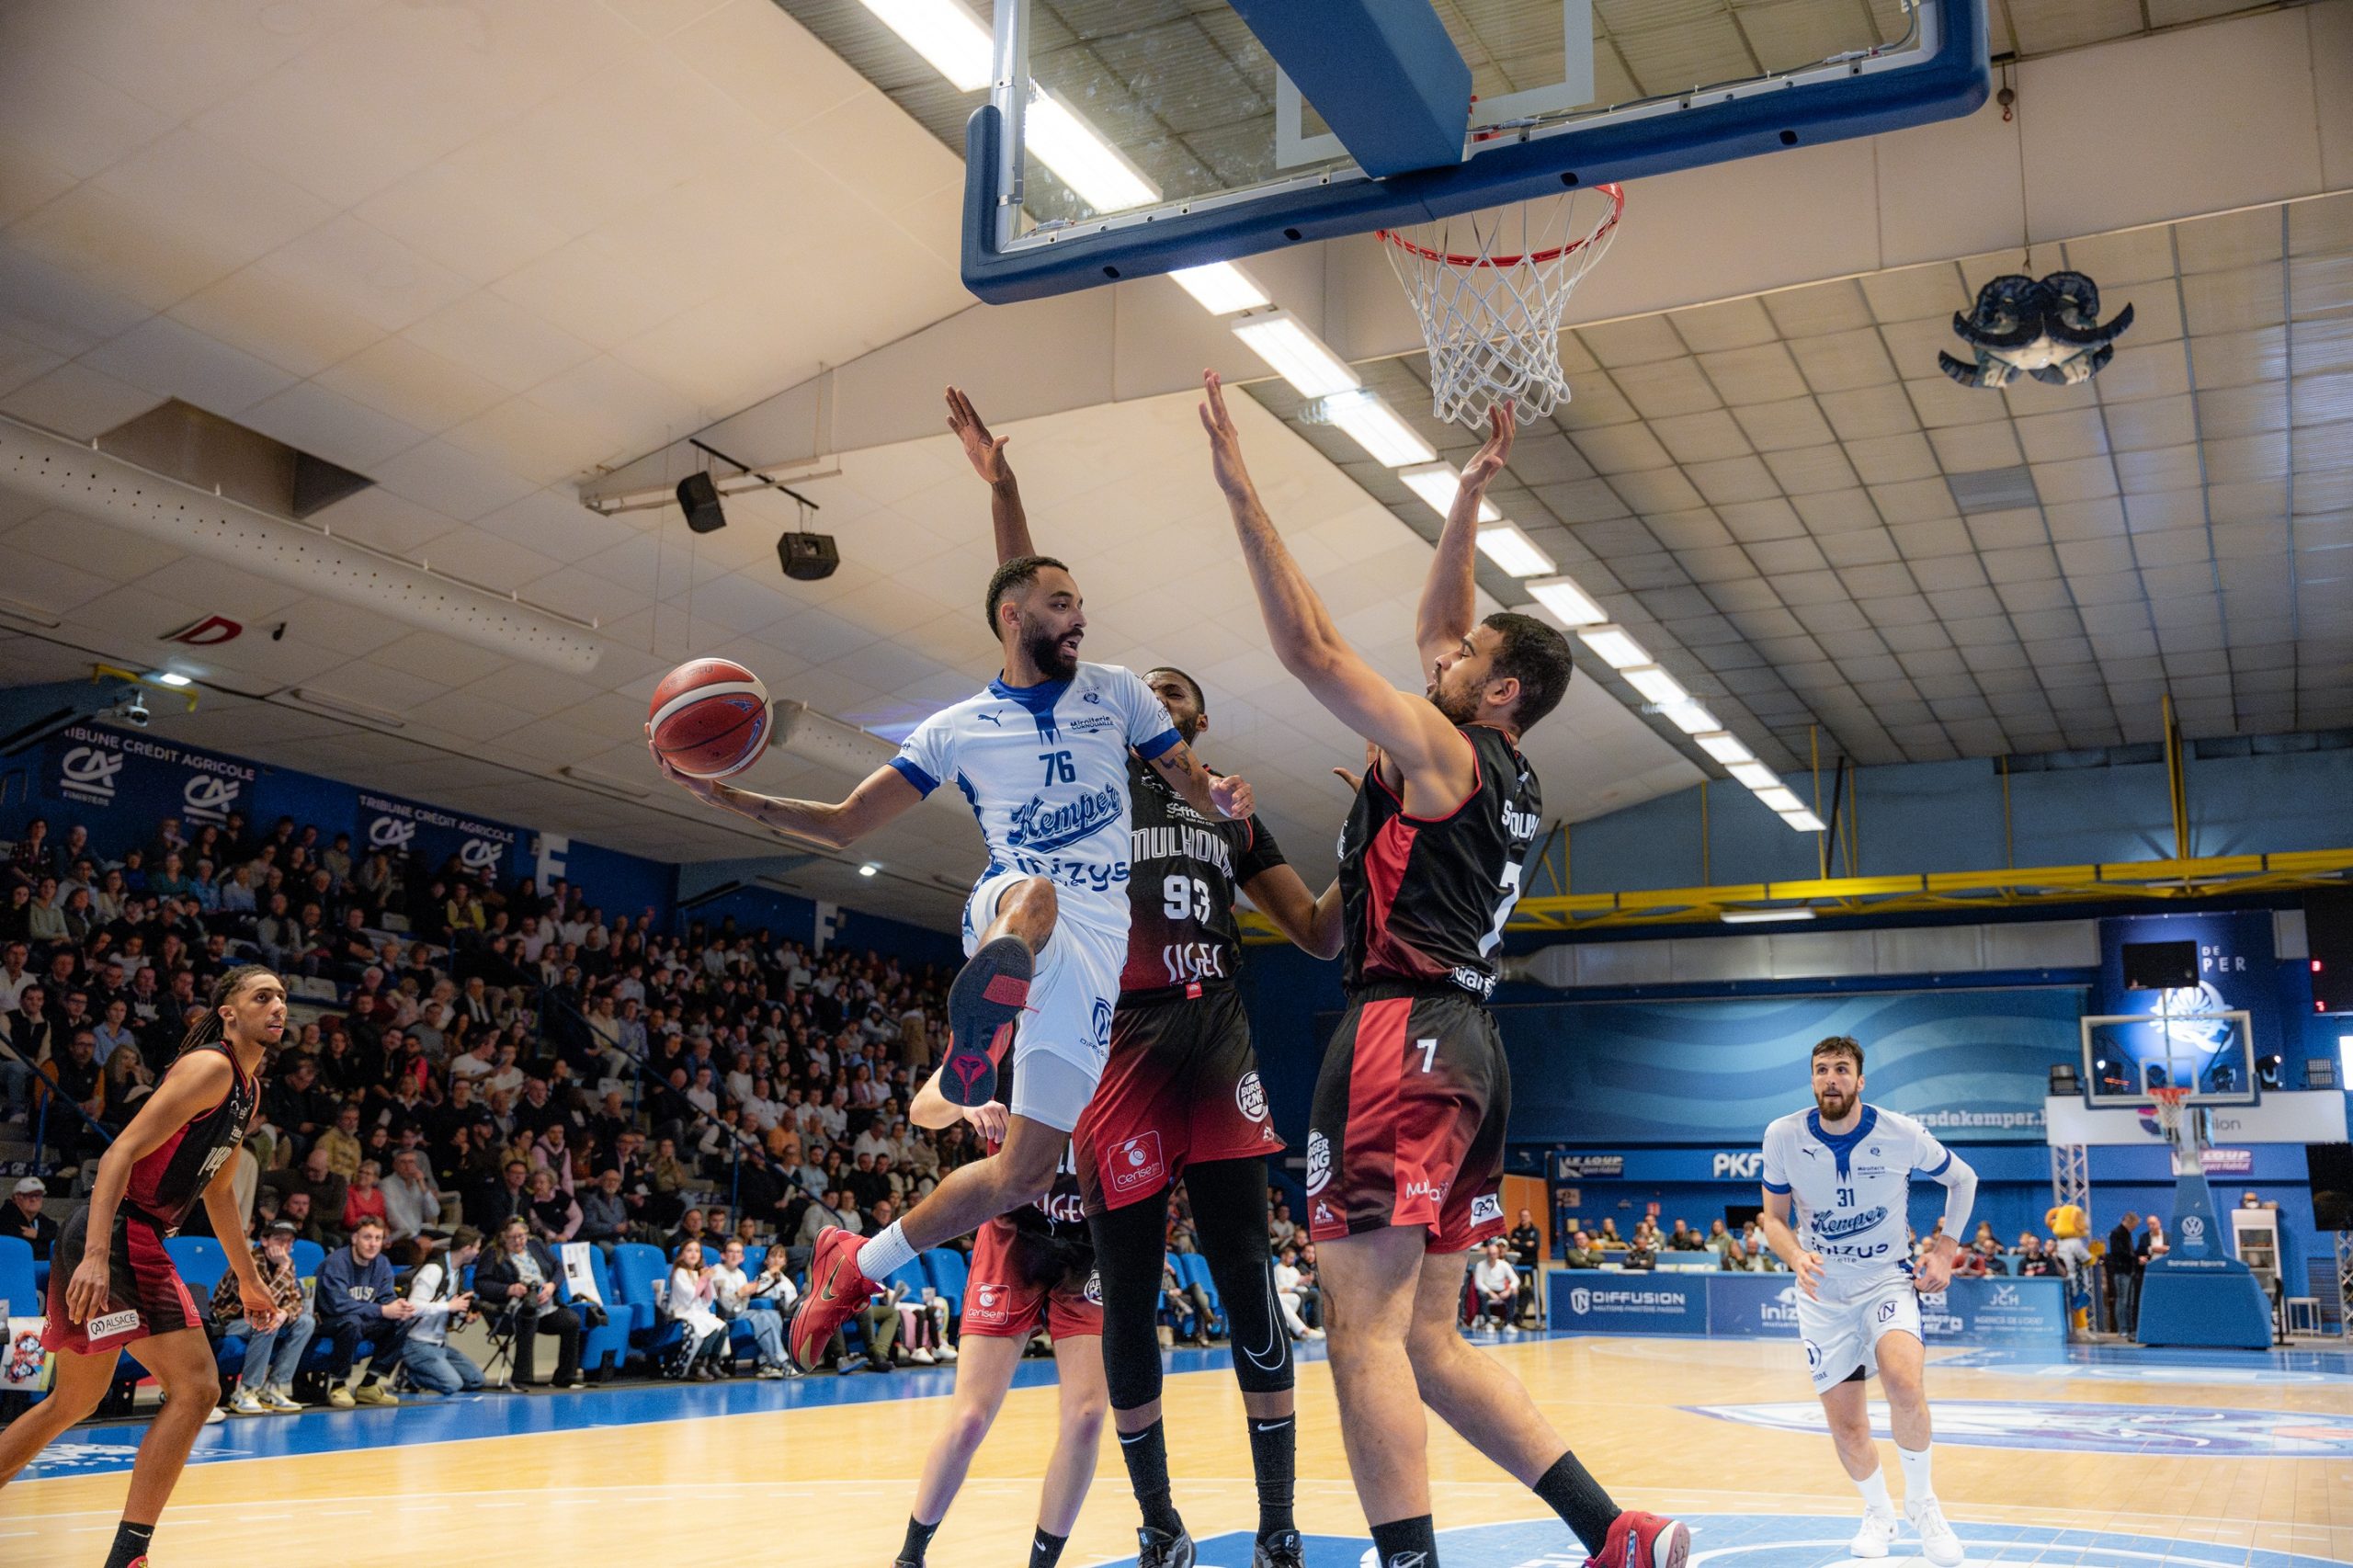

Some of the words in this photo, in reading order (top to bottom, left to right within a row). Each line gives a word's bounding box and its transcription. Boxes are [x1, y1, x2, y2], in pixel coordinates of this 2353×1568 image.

[181, 753, 256, 782] AGRICOLE
[1039, 750, 1076, 787] 76
[358, 794, 414, 819] TRIBUNE
[458, 821, 515, 846] AGRICOLE
[1006, 782, 1121, 846] Kemper
[1163, 874, 1211, 925] 93
[1479, 861, 1522, 957] 7
[2202, 956, 2247, 973] PER
[1416, 1038, 1437, 1073] 7
[1836, 1187, 1855, 1207] 31
[1811, 1206, 1888, 1233] Kemper
[1593, 1290, 1686, 1305] DIFFUSION
[1989, 1293, 2019, 1306] JCH
[106, 1312, 136, 1329] ALSACE
[1760, 1303, 1799, 1321] iniz
